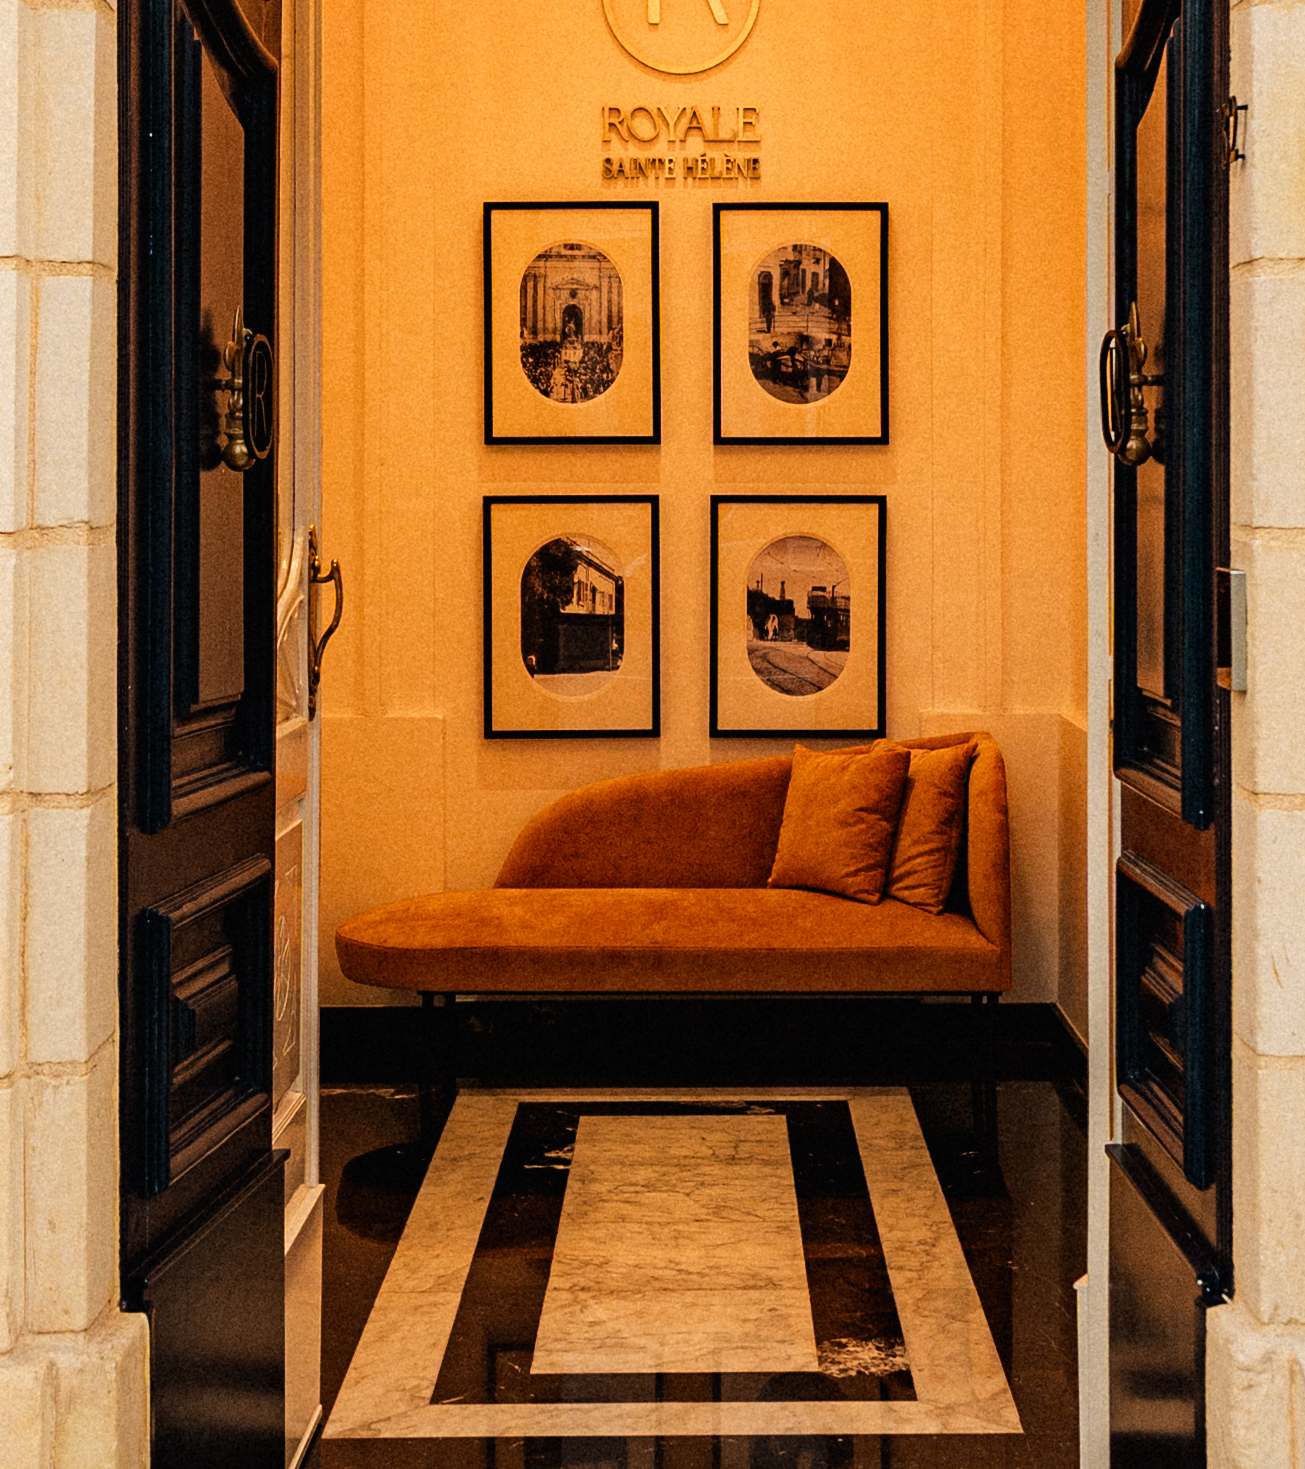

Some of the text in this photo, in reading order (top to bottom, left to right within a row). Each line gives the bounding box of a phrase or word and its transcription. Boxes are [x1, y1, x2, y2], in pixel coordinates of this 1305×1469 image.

[601, 106, 762, 143] ROYALE
[601, 152, 762, 180] SAINTE HÉLÈNE
